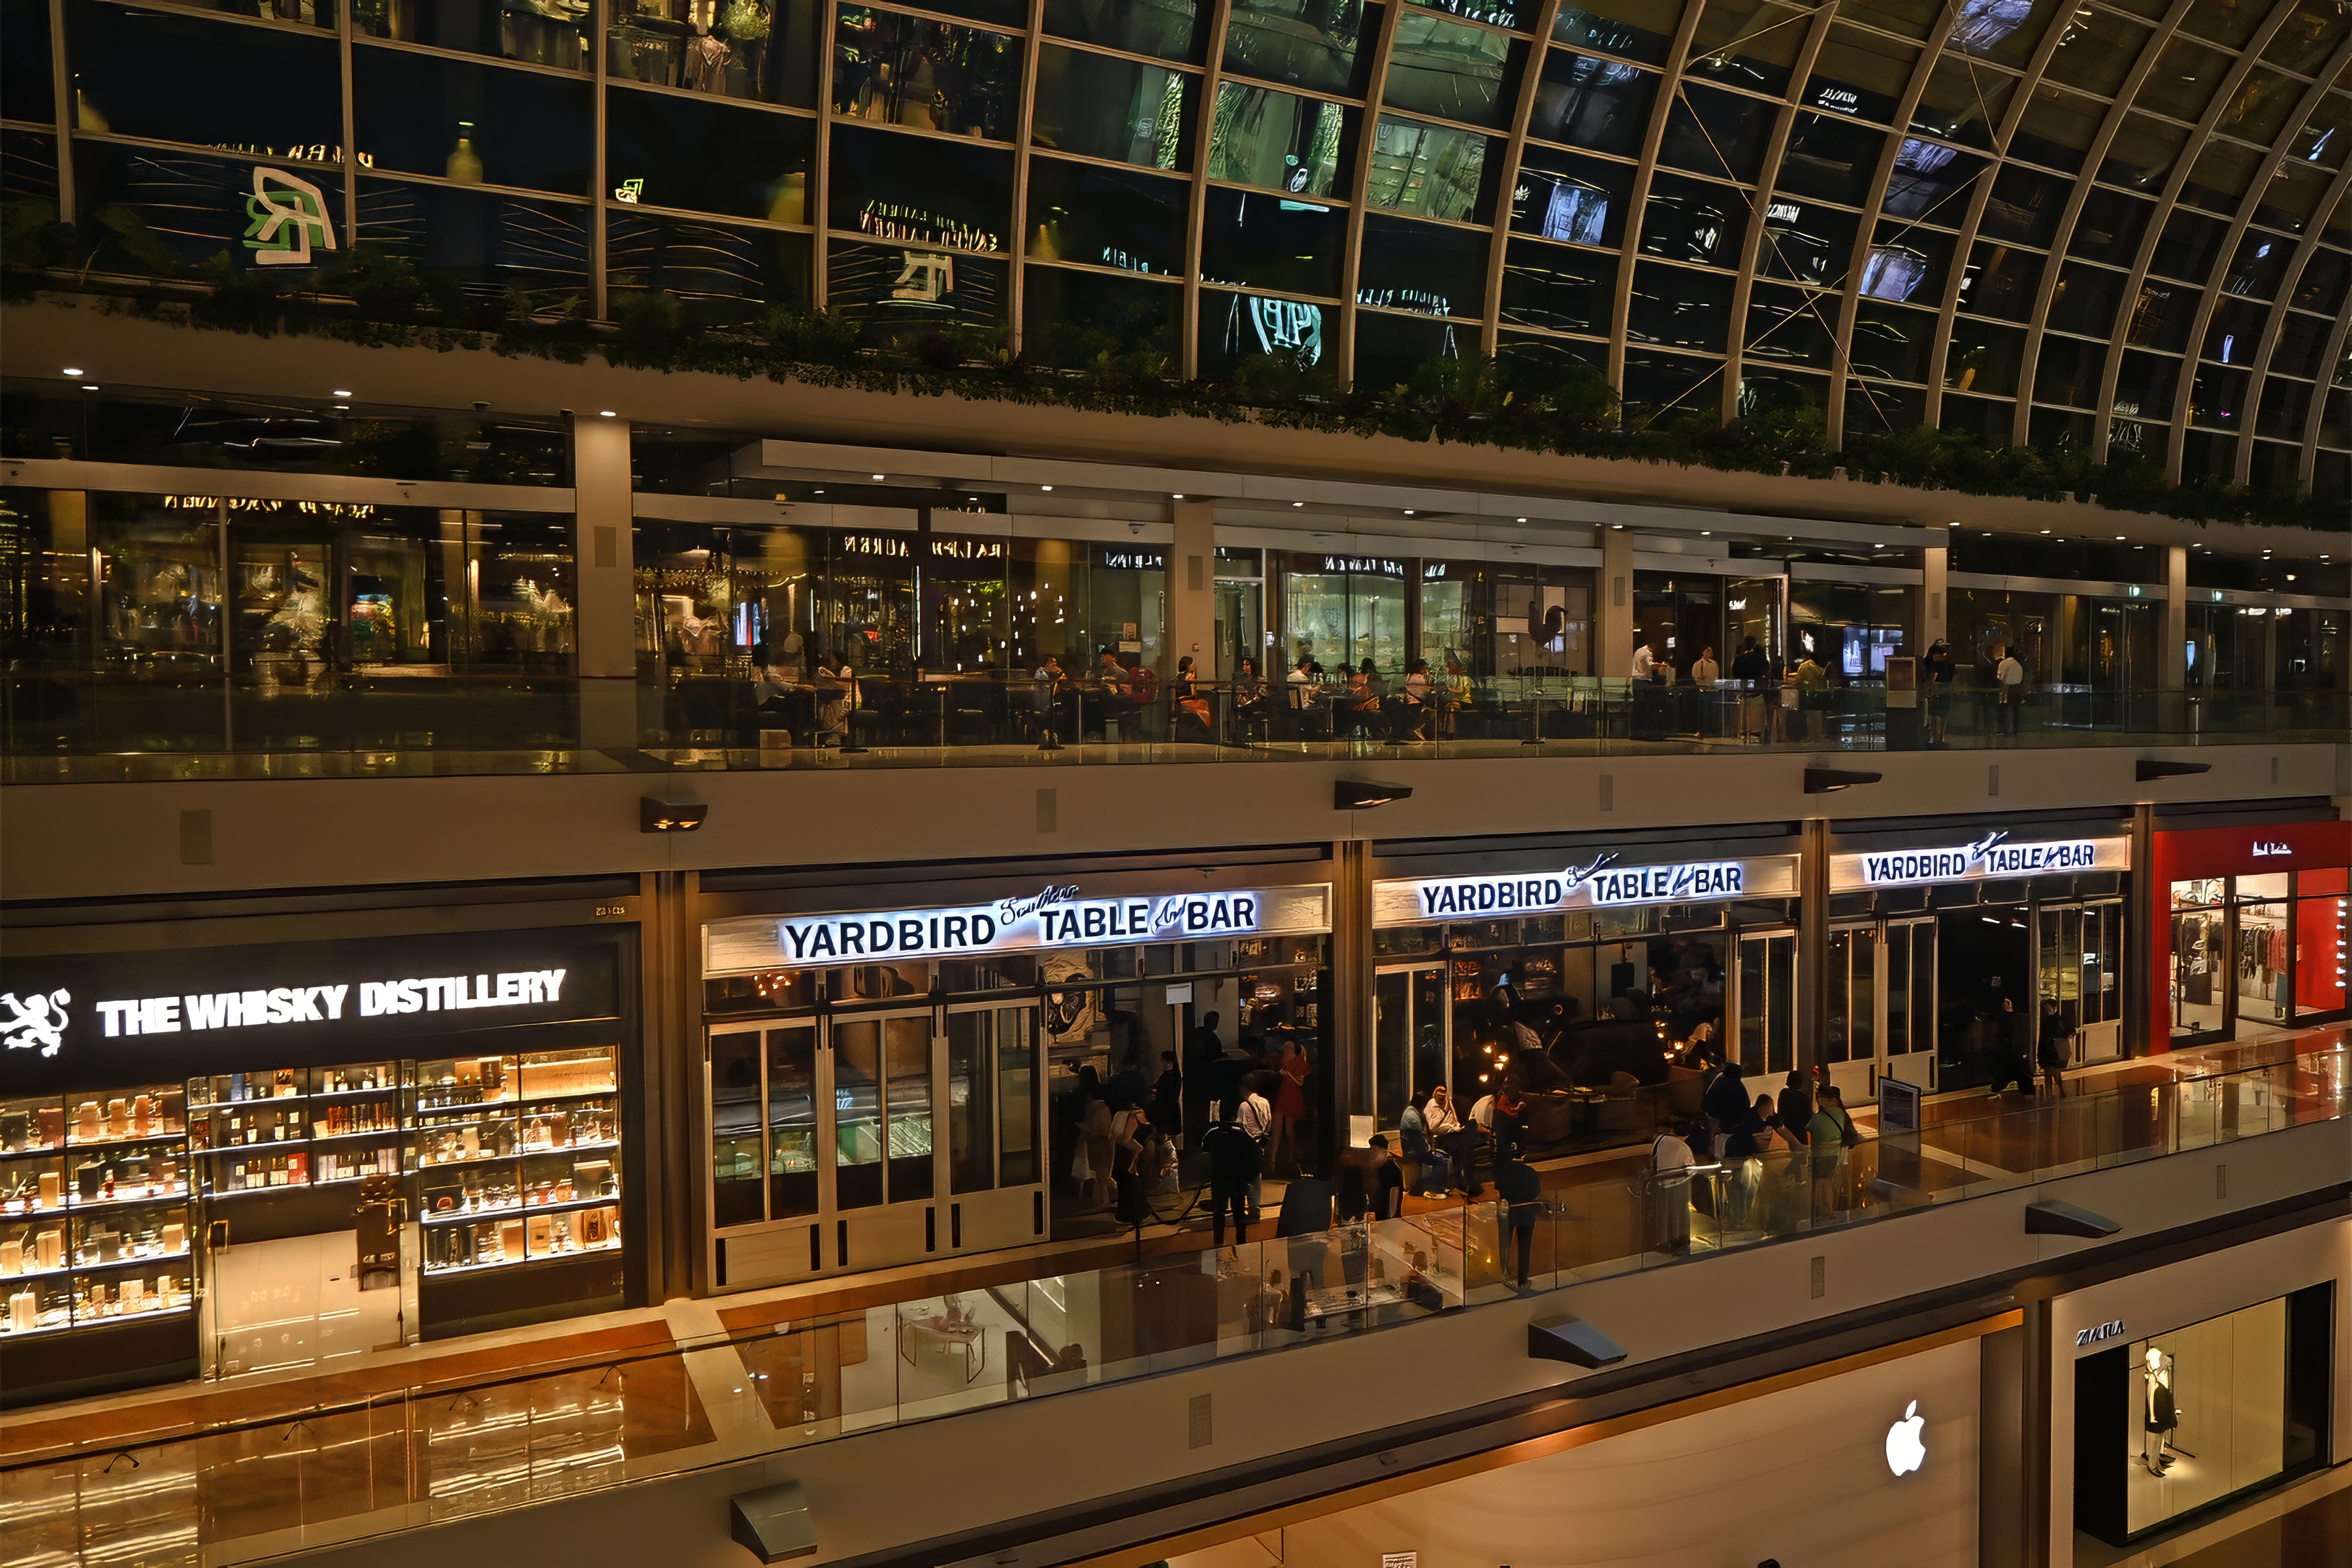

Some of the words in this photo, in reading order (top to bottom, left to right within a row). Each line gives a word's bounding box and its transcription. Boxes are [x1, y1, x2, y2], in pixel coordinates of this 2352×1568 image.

[1868, 854, 1965, 881] YARDBIRD
[1987, 848, 2043, 872] TABLE
[2059, 845, 2094, 866] BAR
[1423, 879, 1561, 913] YARDBIRD
[1593, 872, 1668, 901] TABLE
[1695, 868, 1740, 893] BAR
[785, 915, 996, 958] YARDBIRD
[1040, 905, 1149, 941] TABLE
[1188, 898, 1255, 930] BAR
[96, 996, 180, 1037] THE
[184, 985, 348, 1030] WHISKY
[360, 969, 566, 1016] DISTILLERY
